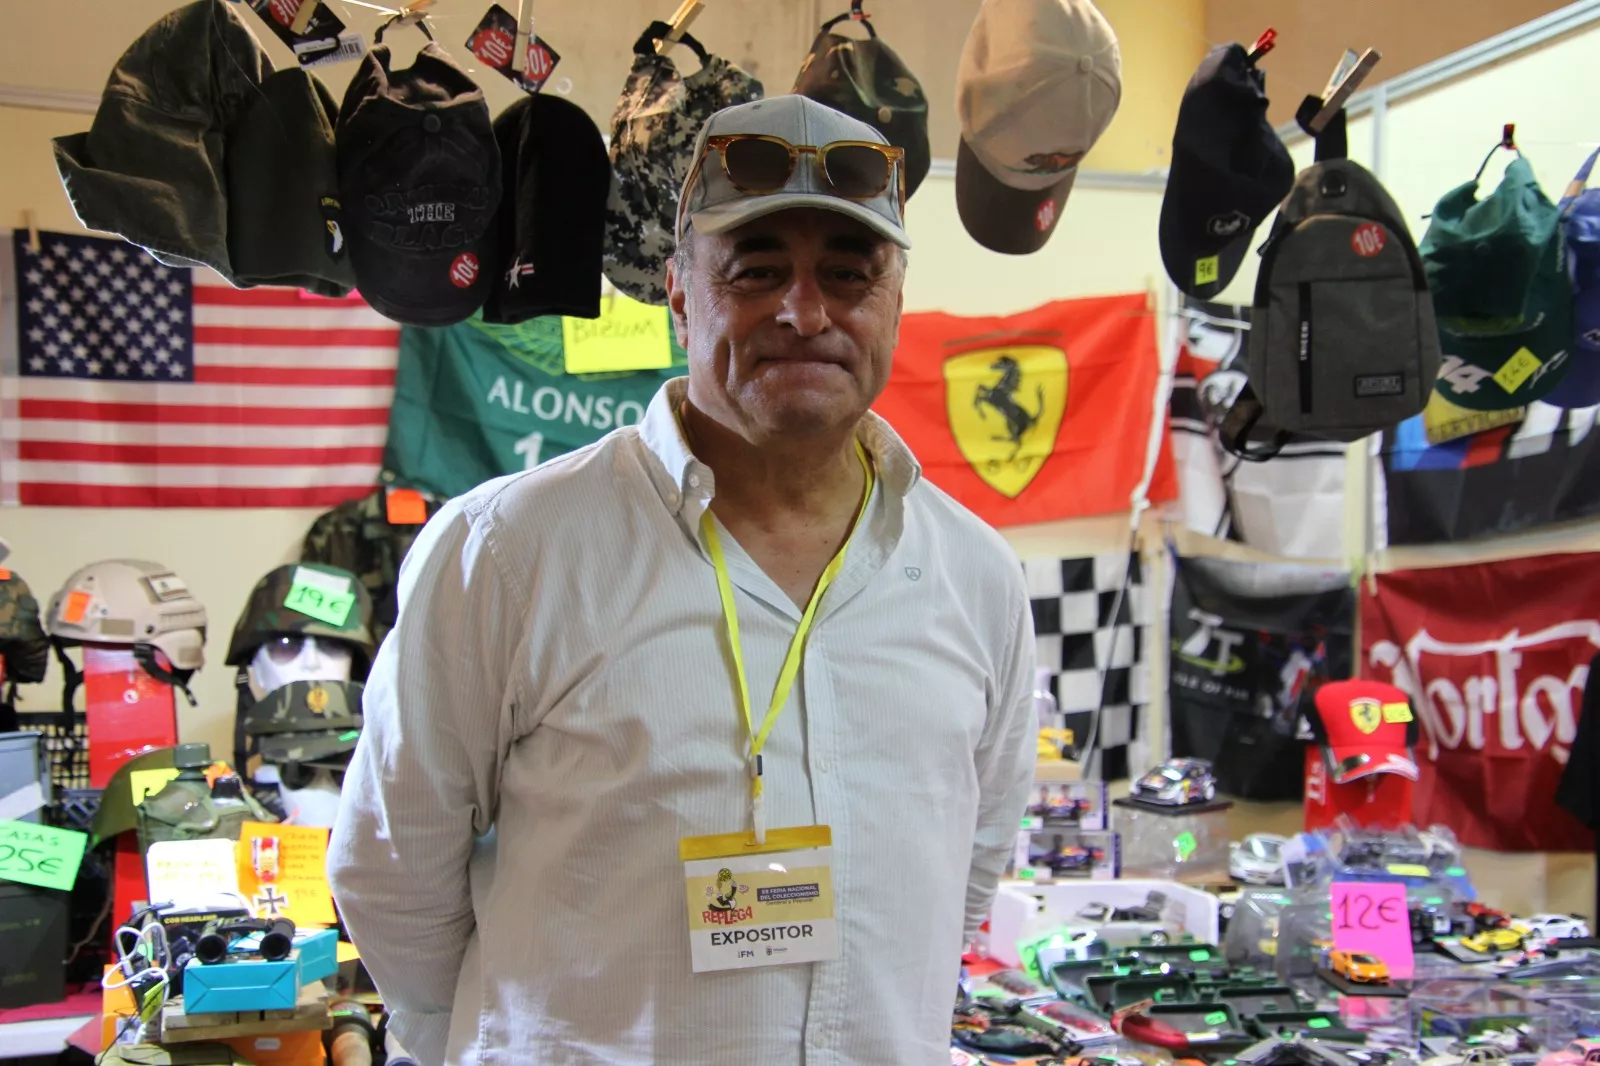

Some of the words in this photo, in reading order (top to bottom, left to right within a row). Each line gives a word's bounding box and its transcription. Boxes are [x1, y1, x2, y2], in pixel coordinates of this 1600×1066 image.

[480, 32, 513, 66] 10€
[1355, 225, 1384, 256] 10€
[452, 255, 480, 285] 10€
[487, 375, 646, 430] ALONSO
[293, 586, 346, 613] 19€
[702, 905, 754, 925] REPLEGA
[1338, 893, 1402, 930] 12€
[710, 924, 813, 946] EXPOSITOR
